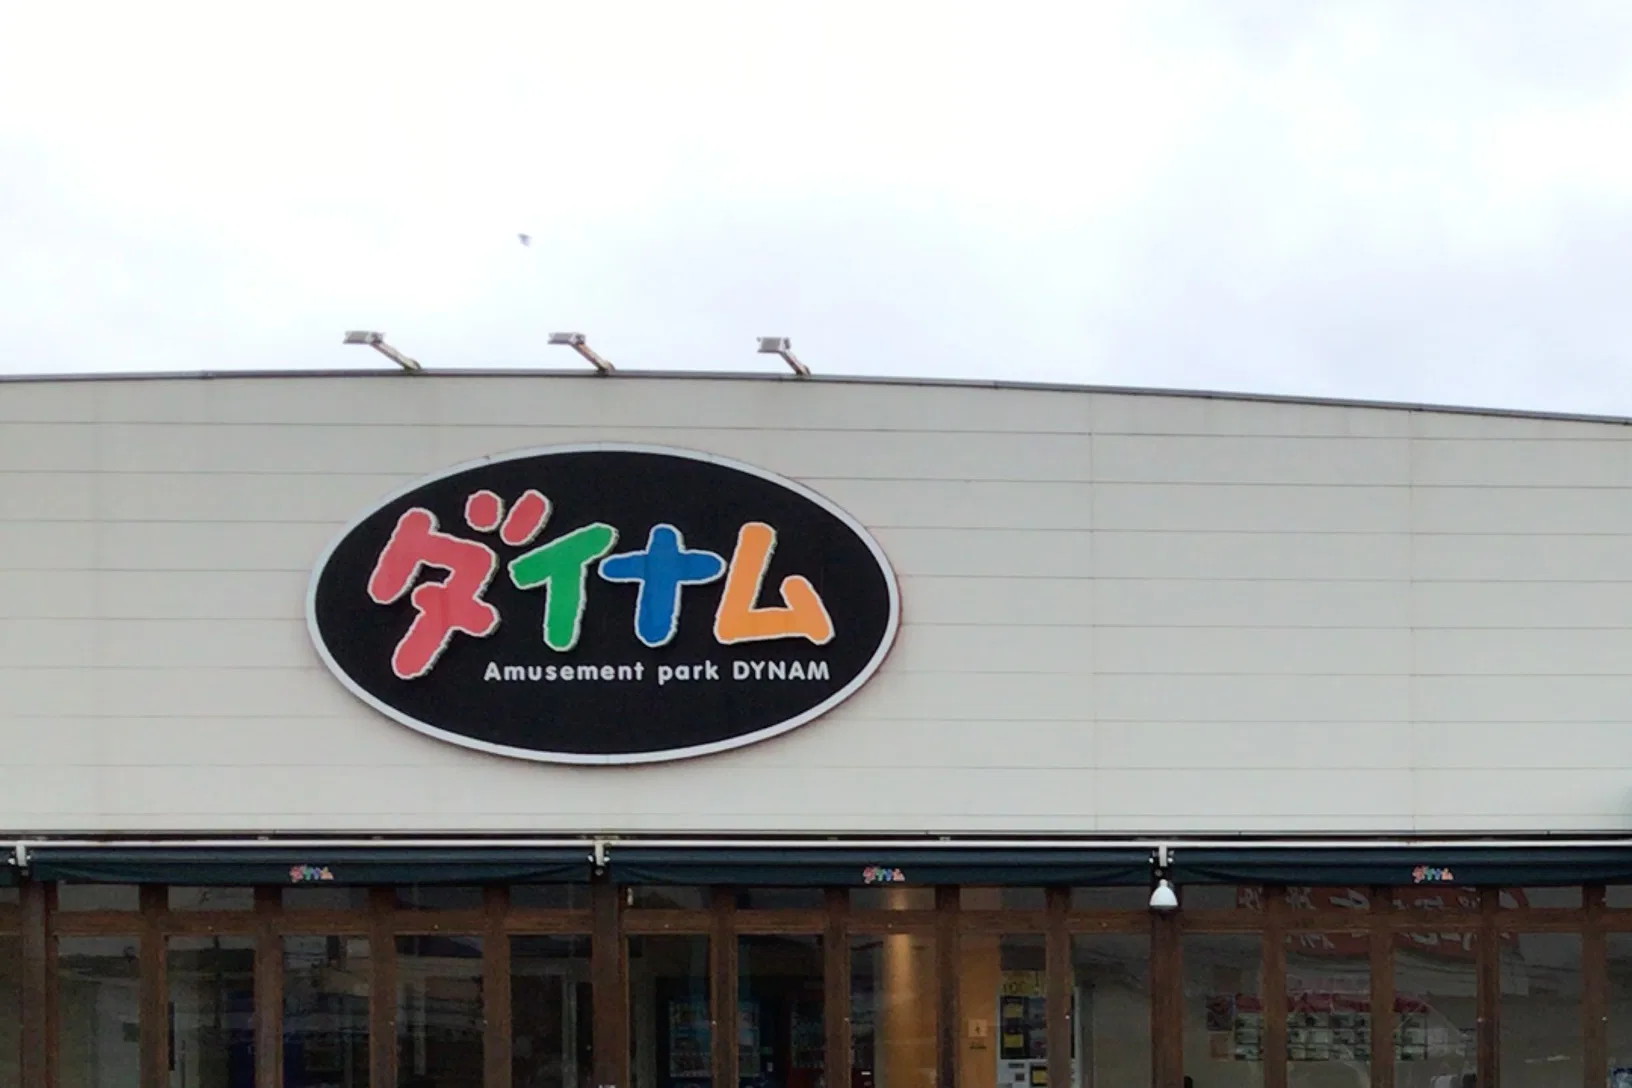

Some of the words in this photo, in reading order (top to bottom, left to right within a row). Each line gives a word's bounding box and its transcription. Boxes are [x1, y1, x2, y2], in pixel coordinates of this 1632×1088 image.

[366, 488, 836, 680] ダイナム
[483, 660, 645, 682] Amusement
[657, 659, 721, 686] park
[732, 660, 831, 681] DYNAM
